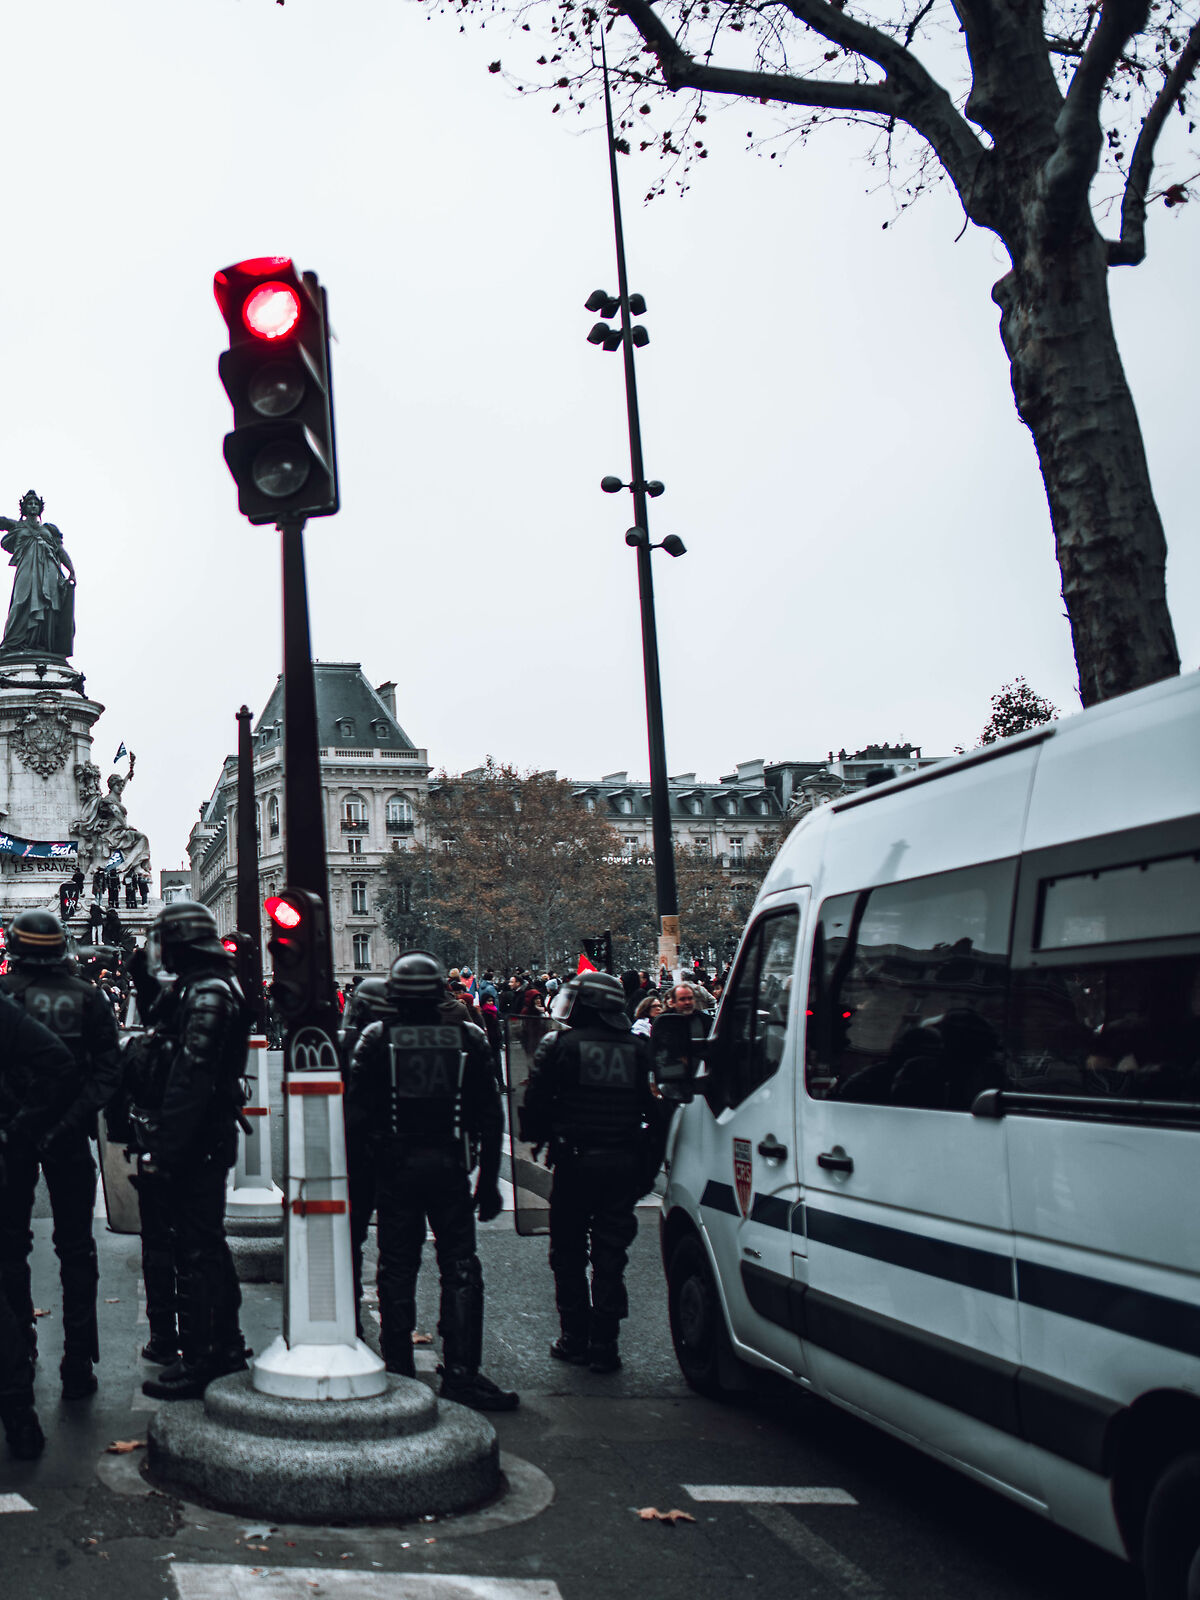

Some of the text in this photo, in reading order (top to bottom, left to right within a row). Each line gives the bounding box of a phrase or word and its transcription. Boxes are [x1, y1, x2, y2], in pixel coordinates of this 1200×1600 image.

[15, 863, 33, 873] LES
[34, 993, 75, 1030] 3C
[395, 1028, 457, 1047] CRS
[407, 1055, 451, 1097] 3A
[587, 1046, 629, 1083] 3A
[736, 1163, 751, 1182] CRS
